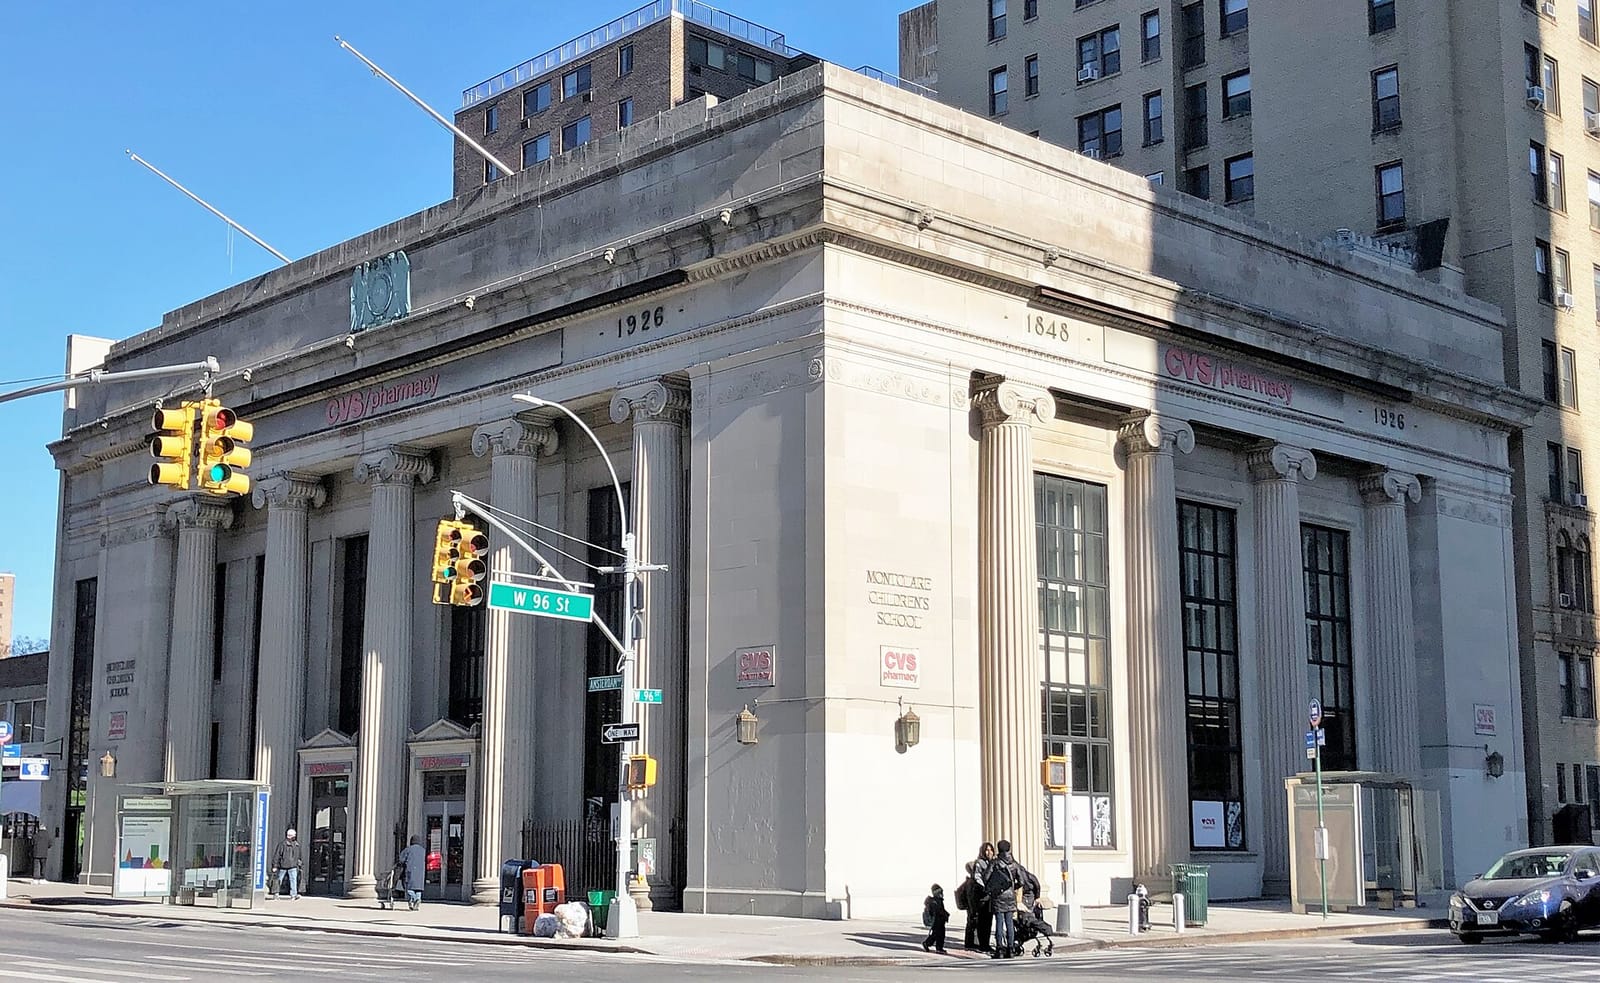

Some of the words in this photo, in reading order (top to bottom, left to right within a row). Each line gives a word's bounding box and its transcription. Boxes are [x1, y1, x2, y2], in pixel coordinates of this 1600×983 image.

[618, 306, 664, 338] 1926
[1027, 313, 1069, 342] 1848
[1374, 407, 1405, 430] 1926
[866, 570, 931, 591] MONTCLARE
[513, 590, 527, 607] W
[533, 593, 550, 610] 96
[556, 597, 569, 613] St
[869, 591, 929, 610] CHILDREN'S
[877, 611, 922, 629] SCHOOL
[740, 651, 770, 670] CVS
[884, 651, 917, 671] CVS
[883, 670, 918, 683] pharmacy
[644, 691, 654, 701] 96
